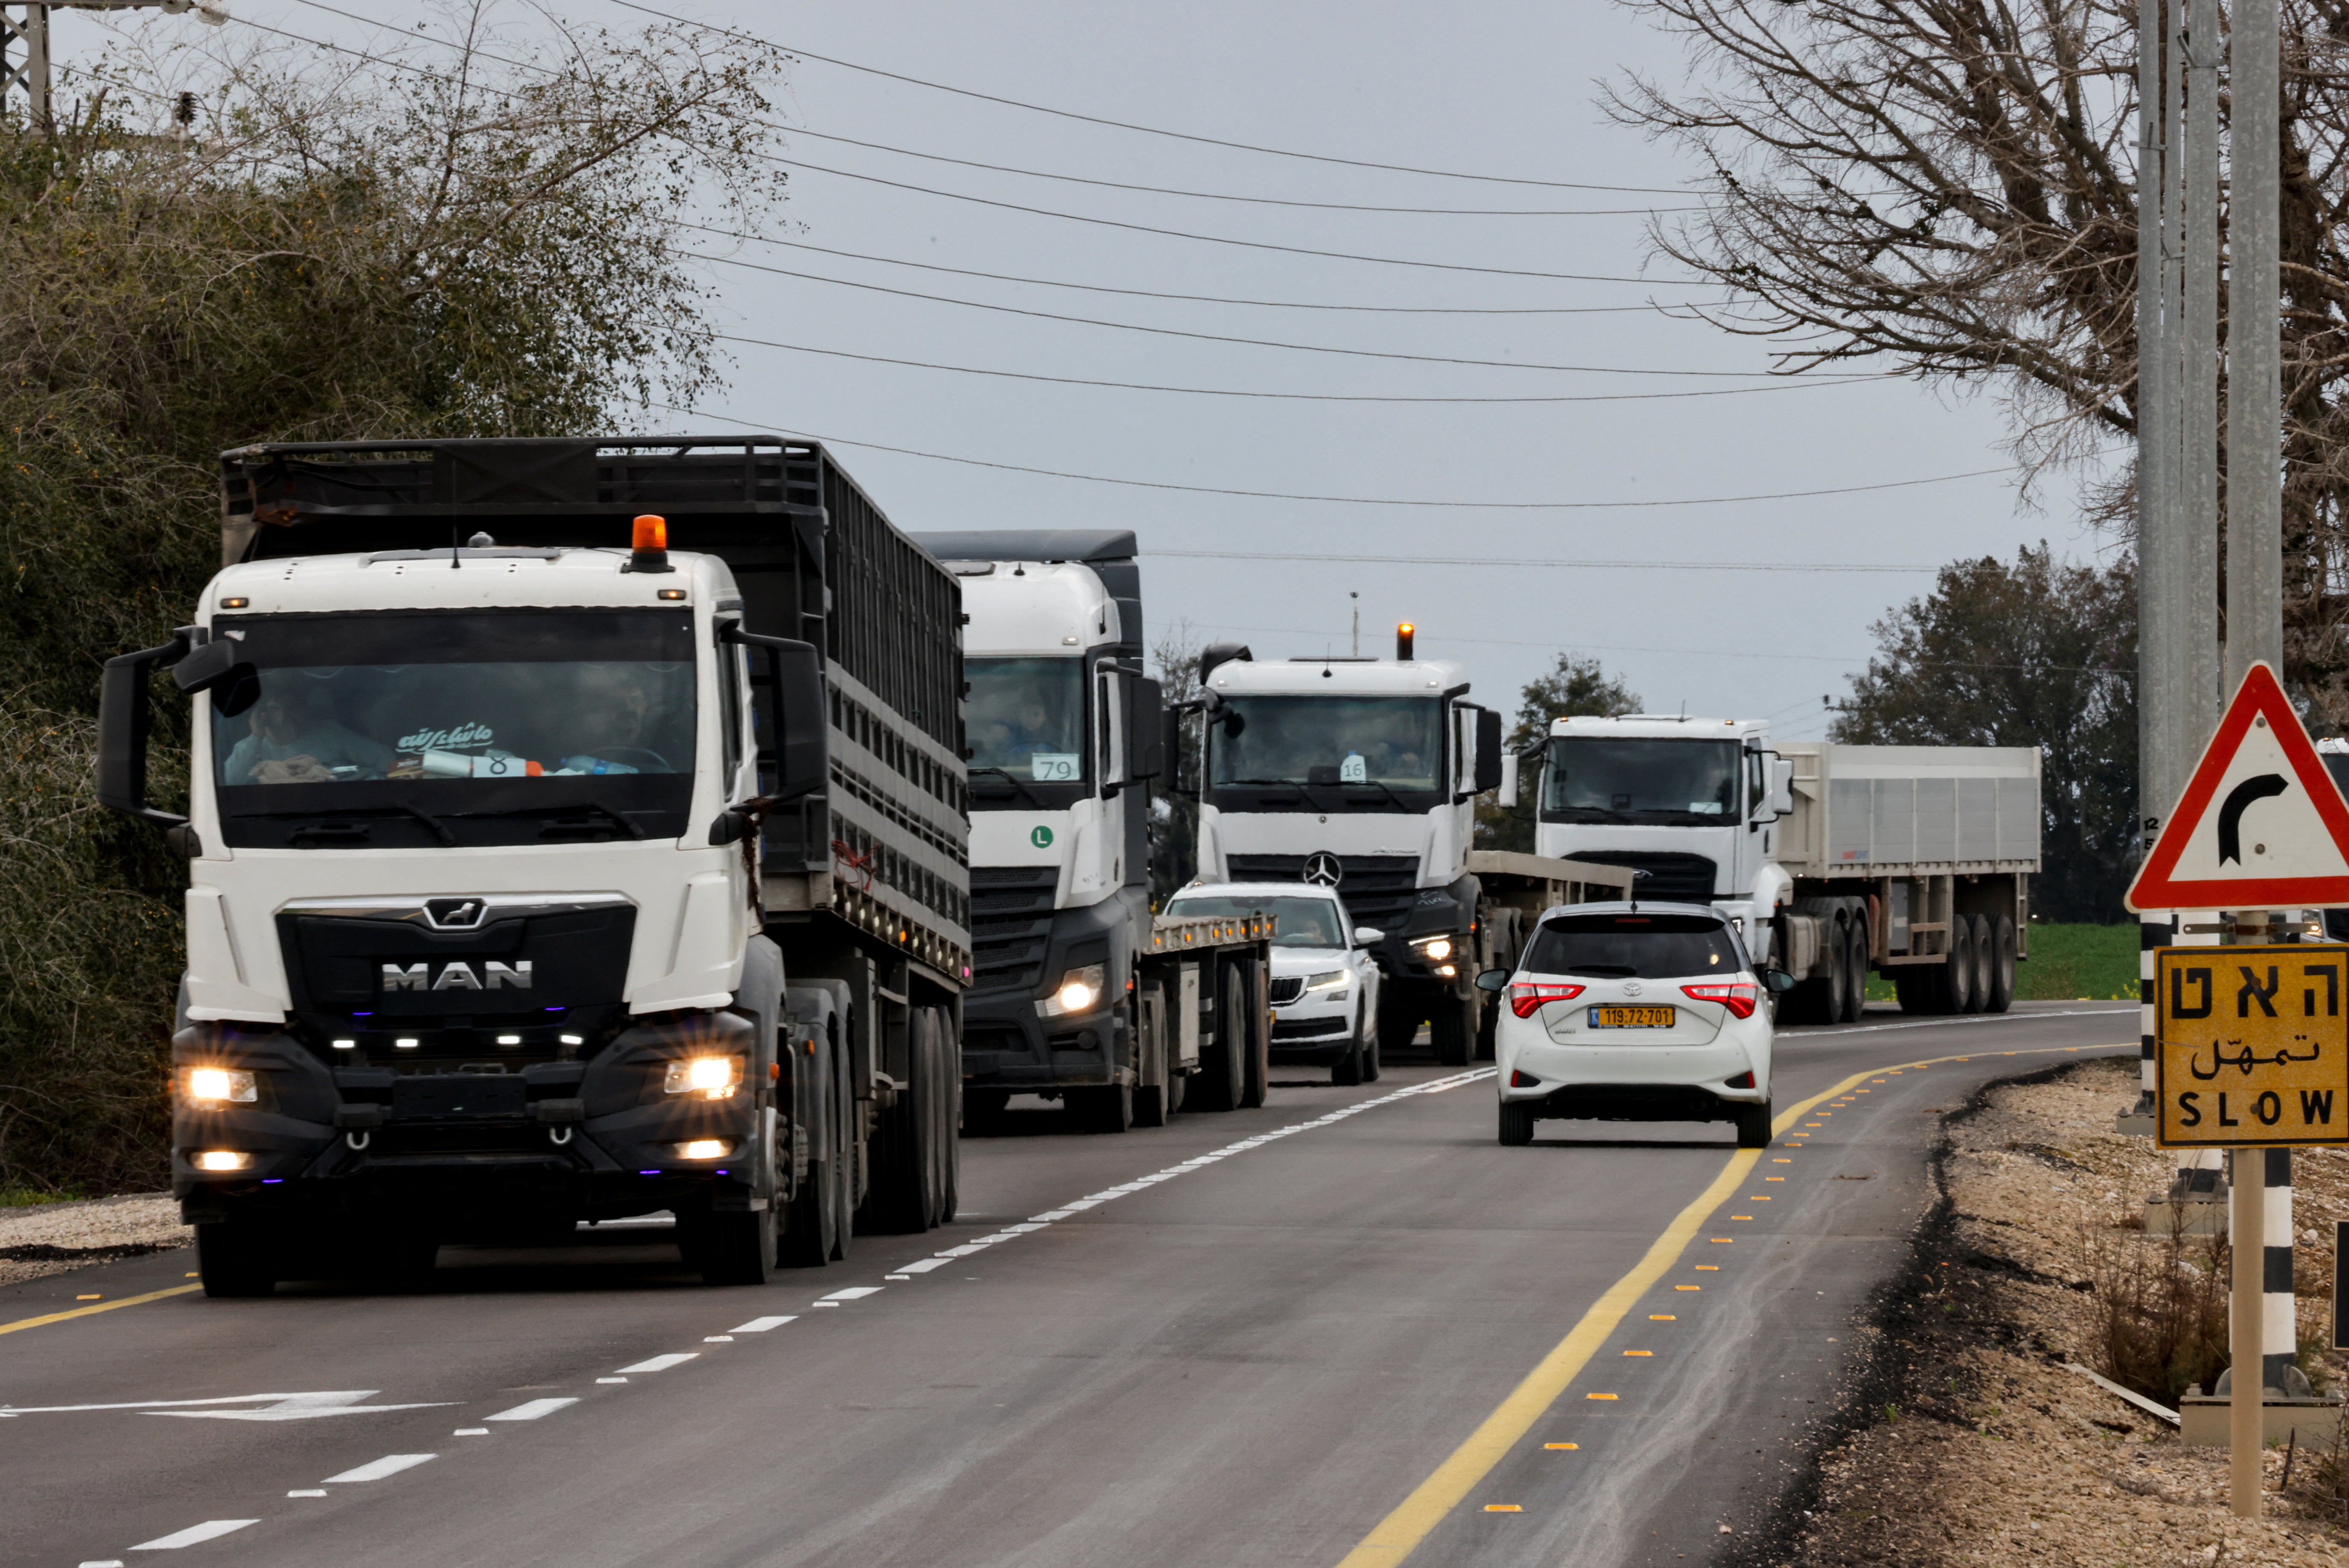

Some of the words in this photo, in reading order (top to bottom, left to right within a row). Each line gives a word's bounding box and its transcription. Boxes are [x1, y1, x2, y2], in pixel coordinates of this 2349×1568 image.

[1040, 761, 1071, 780] 79
[1344, 763, 1362, 777] 16
[2144, 818, 2159, 831] 12
[1037, 829, 1048, 844] L
[382, 961, 533, 992] MAN
[2171, 964, 2338, 1019] האט
[2179, 1090, 2334, 1127] SLOW
